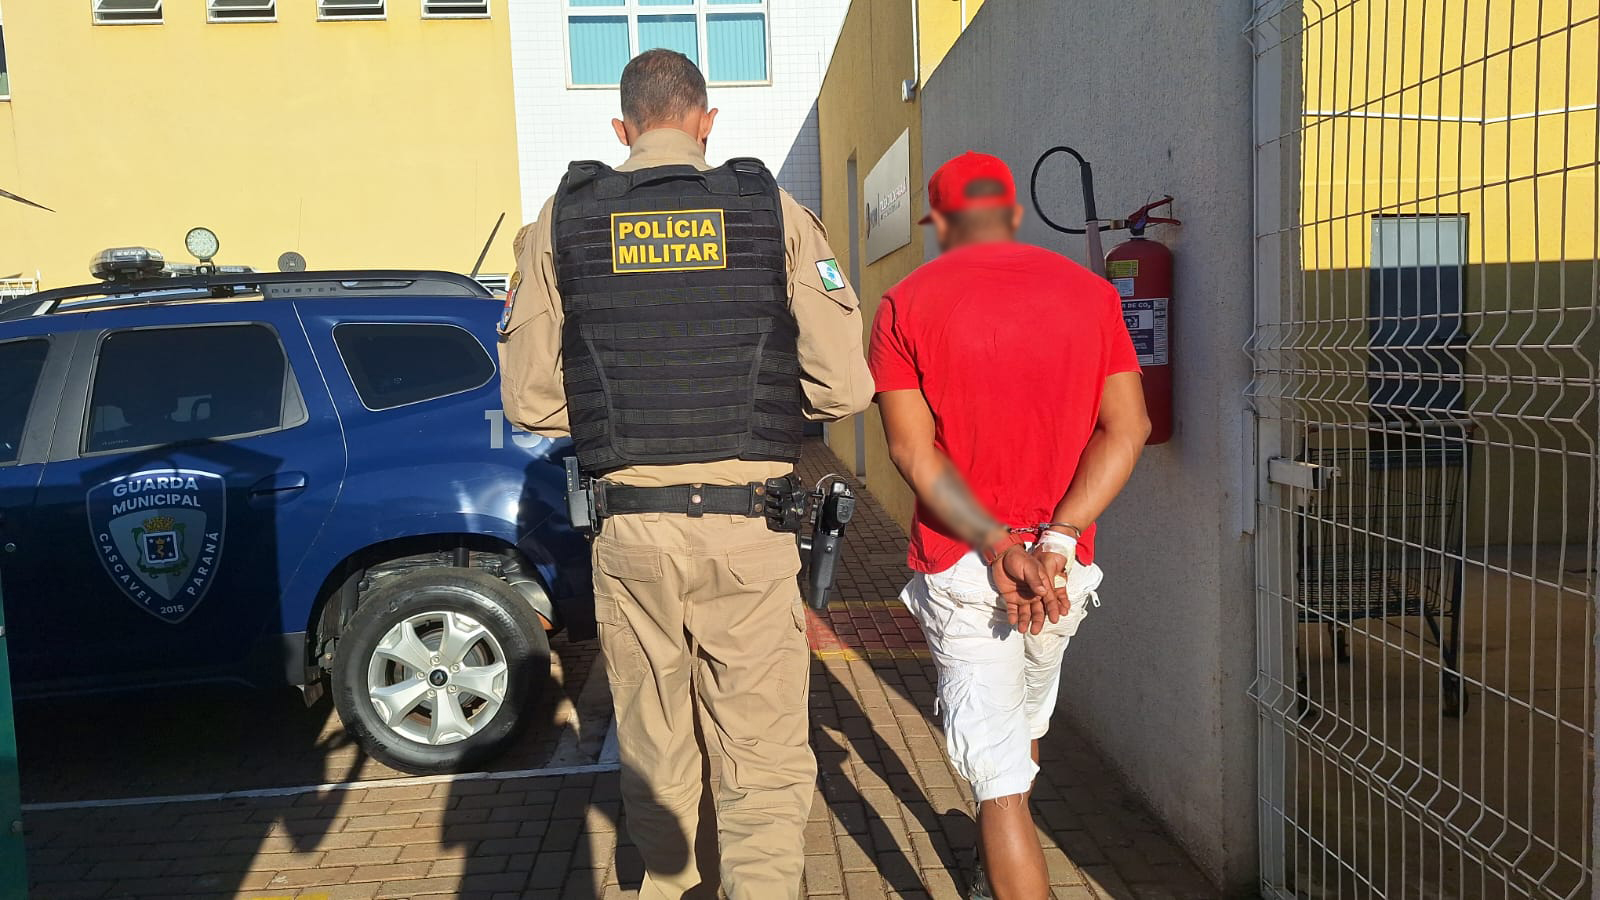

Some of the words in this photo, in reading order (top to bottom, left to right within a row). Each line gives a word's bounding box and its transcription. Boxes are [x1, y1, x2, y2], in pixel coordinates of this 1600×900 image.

[618, 216, 717, 240] POLÍCIA
[618, 242, 720, 265] MILITAR
[113, 476, 199, 497] GUARDA
[112, 493, 201, 515] MUNICIPAL
[99, 532, 153, 606] CASCAVEL
[186, 532, 219, 596] PARANÁ
[160, 604, 185, 614] 2015
